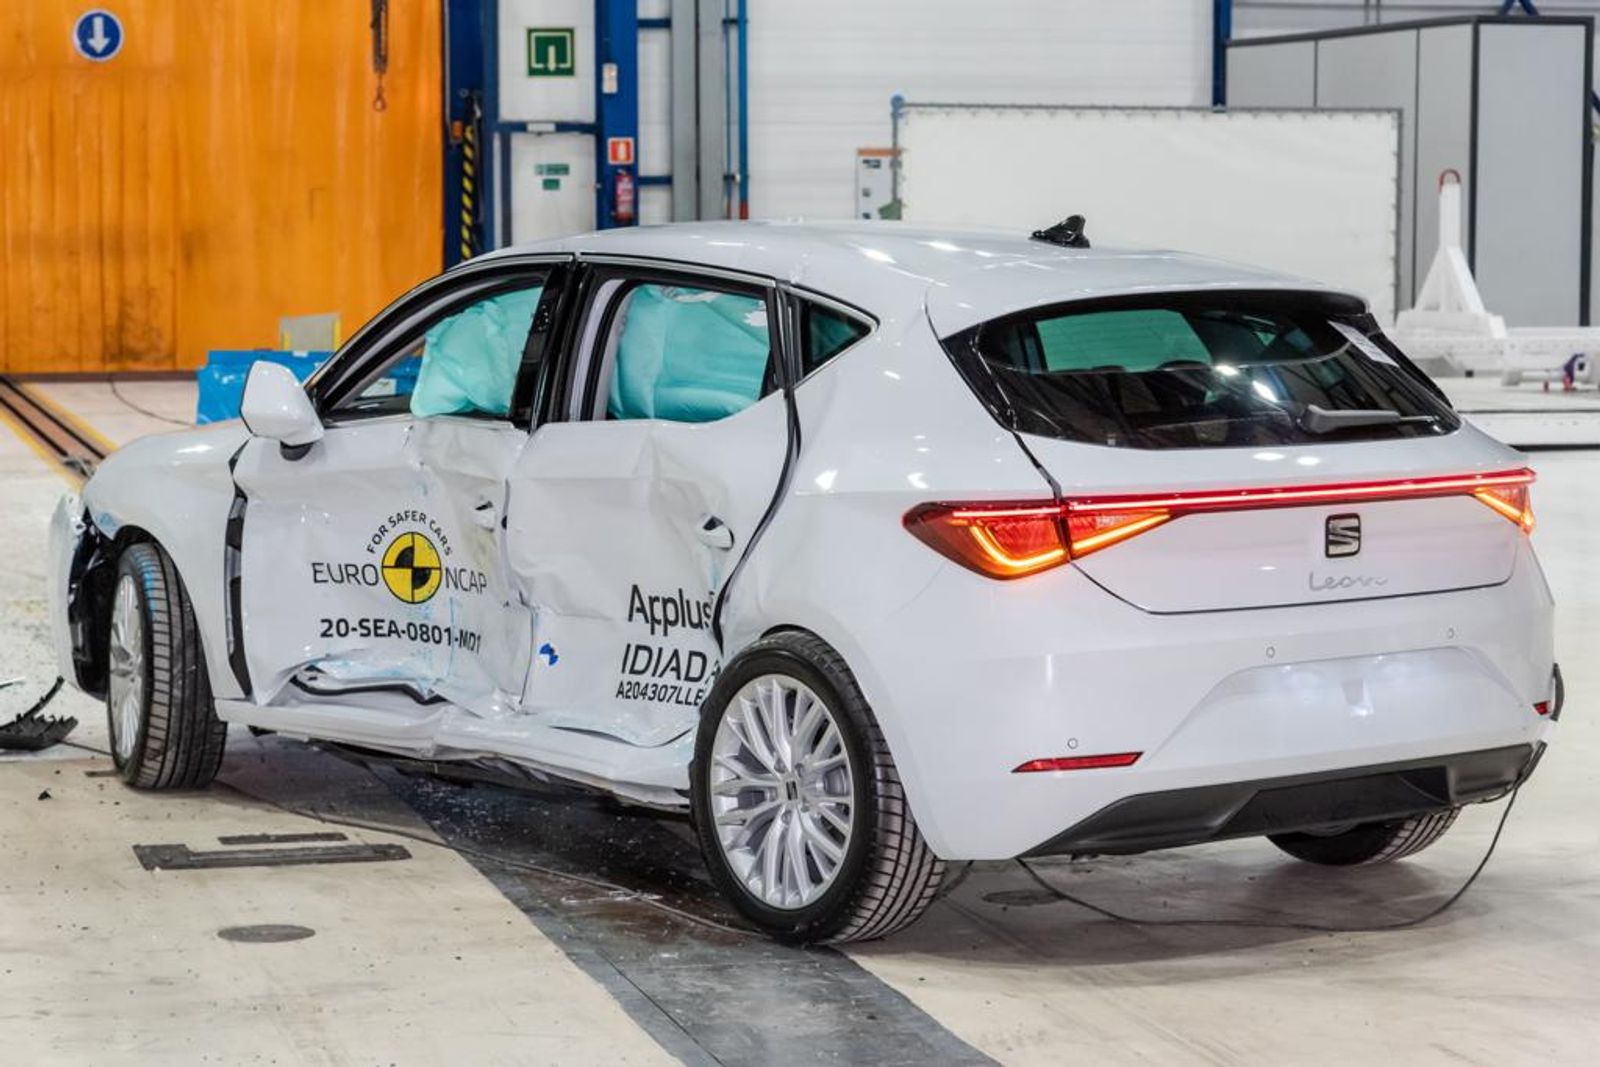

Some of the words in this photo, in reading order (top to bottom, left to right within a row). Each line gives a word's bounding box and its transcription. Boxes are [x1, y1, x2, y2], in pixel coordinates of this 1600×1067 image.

[366, 525, 389, 554] FOR
[388, 510, 427, 528] SAFER
[429, 519, 453, 556] CARS
[311, 562, 380, 586] EURO
[445, 567, 487, 594] NCAP
[628, 584, 715, 636] Applus
